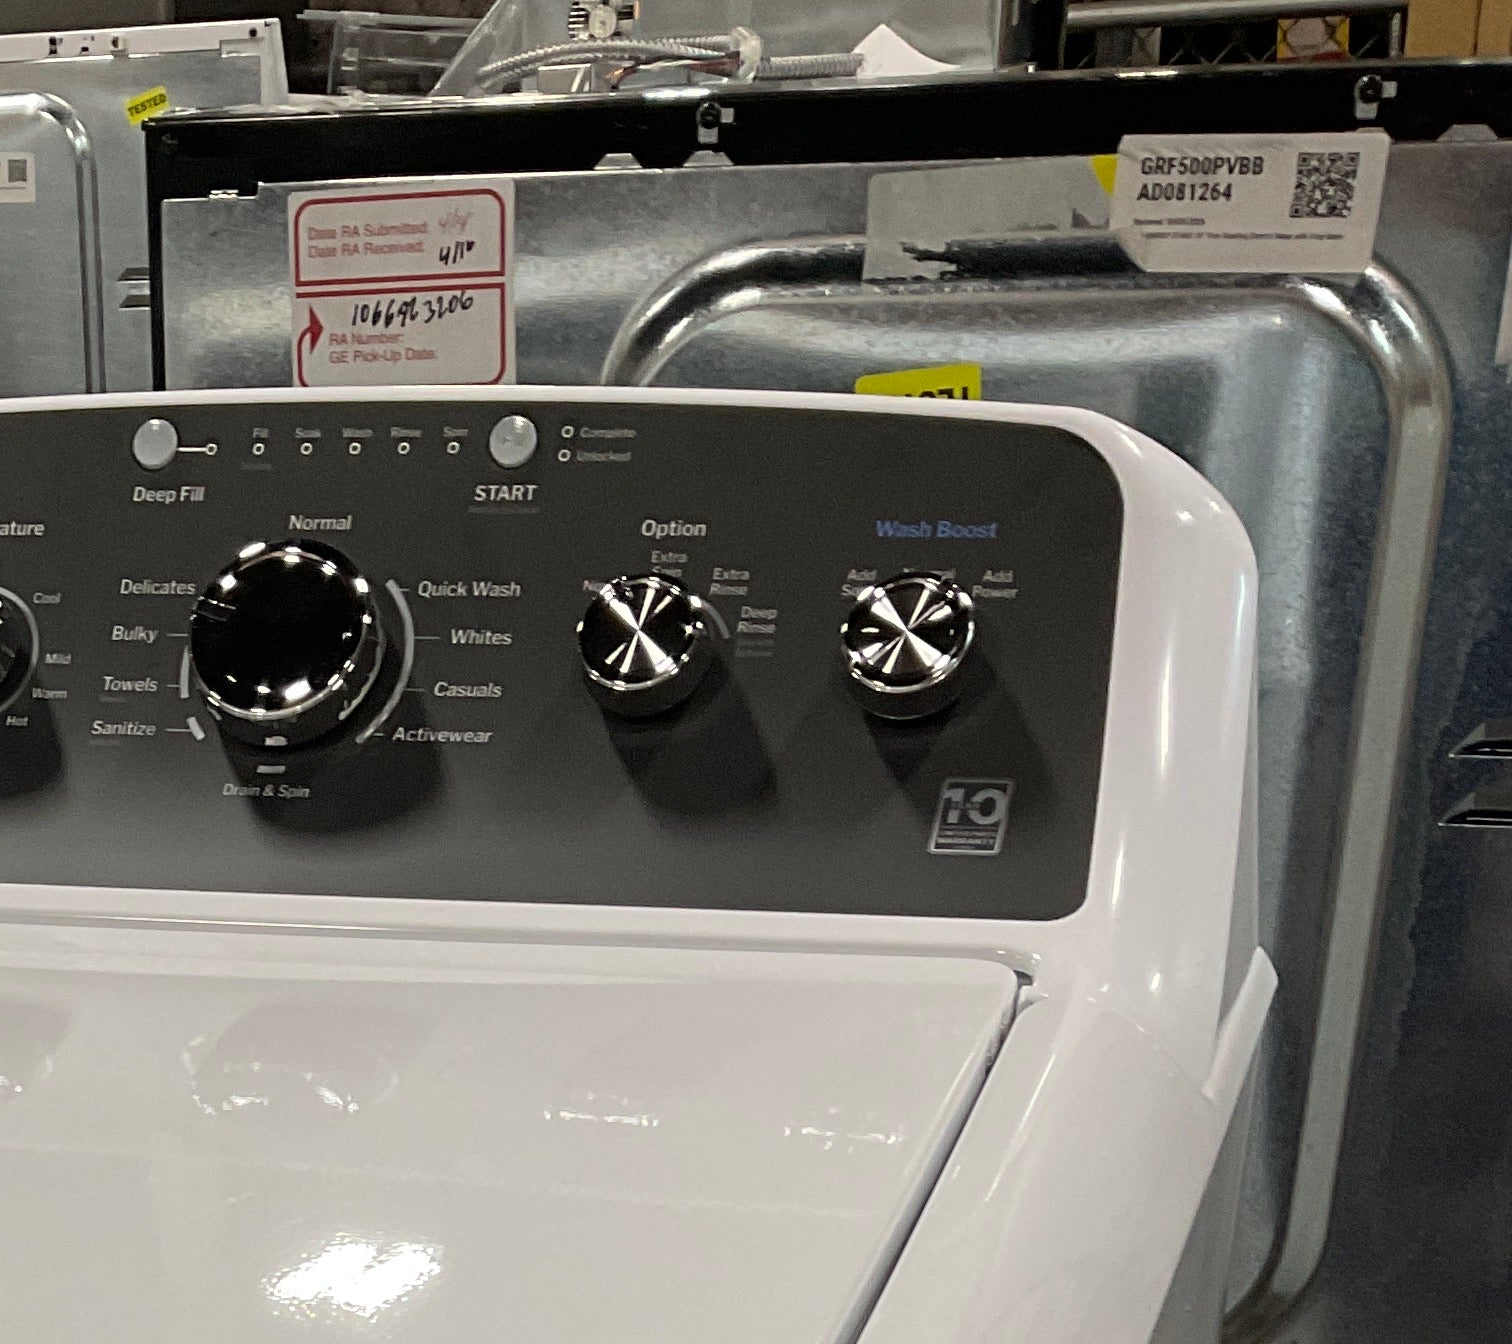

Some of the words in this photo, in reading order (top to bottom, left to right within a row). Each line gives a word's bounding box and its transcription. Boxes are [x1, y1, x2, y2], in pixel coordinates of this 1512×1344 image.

[127, 92, 168, 118] TESTED
[1140, 155, 1265, 176] GRF500PVBB
[1137, 182, 1234, 202] AD081264
[341, 225, 361, 238] RA
[341, 243, 361, 256] RA
[329, 332, 348, 346] RA
[329, 350, 349, 364] GE
[132, 486, 177, 504] Deep
[180, 485, 205, 502] Fill
[473, 484, 539, 501] START
[288, 514, 353, 532] Normal
[640, 518, 708, 540] Option
[875, 519, 932, 538] Wash
[936, 520, 999, 538] Boost
[650, 549, 688, 564] Extra
[711, 566, 751, 581] Extra
[119, 578, 197, 596] Delicates
[417, 580, 468, 599] Quick
[471, 580, 522, 598] Wash
[32, 592, 61, 605] Cool
[110, 625, 159, 645] Bulky
[450, 628, 514, 647] Whites
[44, 653, 72, 666] Mild
[102, 675, 159, 693] Towels
[432, 681, 504, 699] Casuals
[5, 715, 29, 728] Hot
[90, 719, 157, 736] Sanitize
[392, 725, 494, 744] Activewear
[222, 783, 261, 797] Drain
[262, 783, 275, 797] &
[277, 783, 311, 799] Spin
[942, 787, 1006, 825] 10
